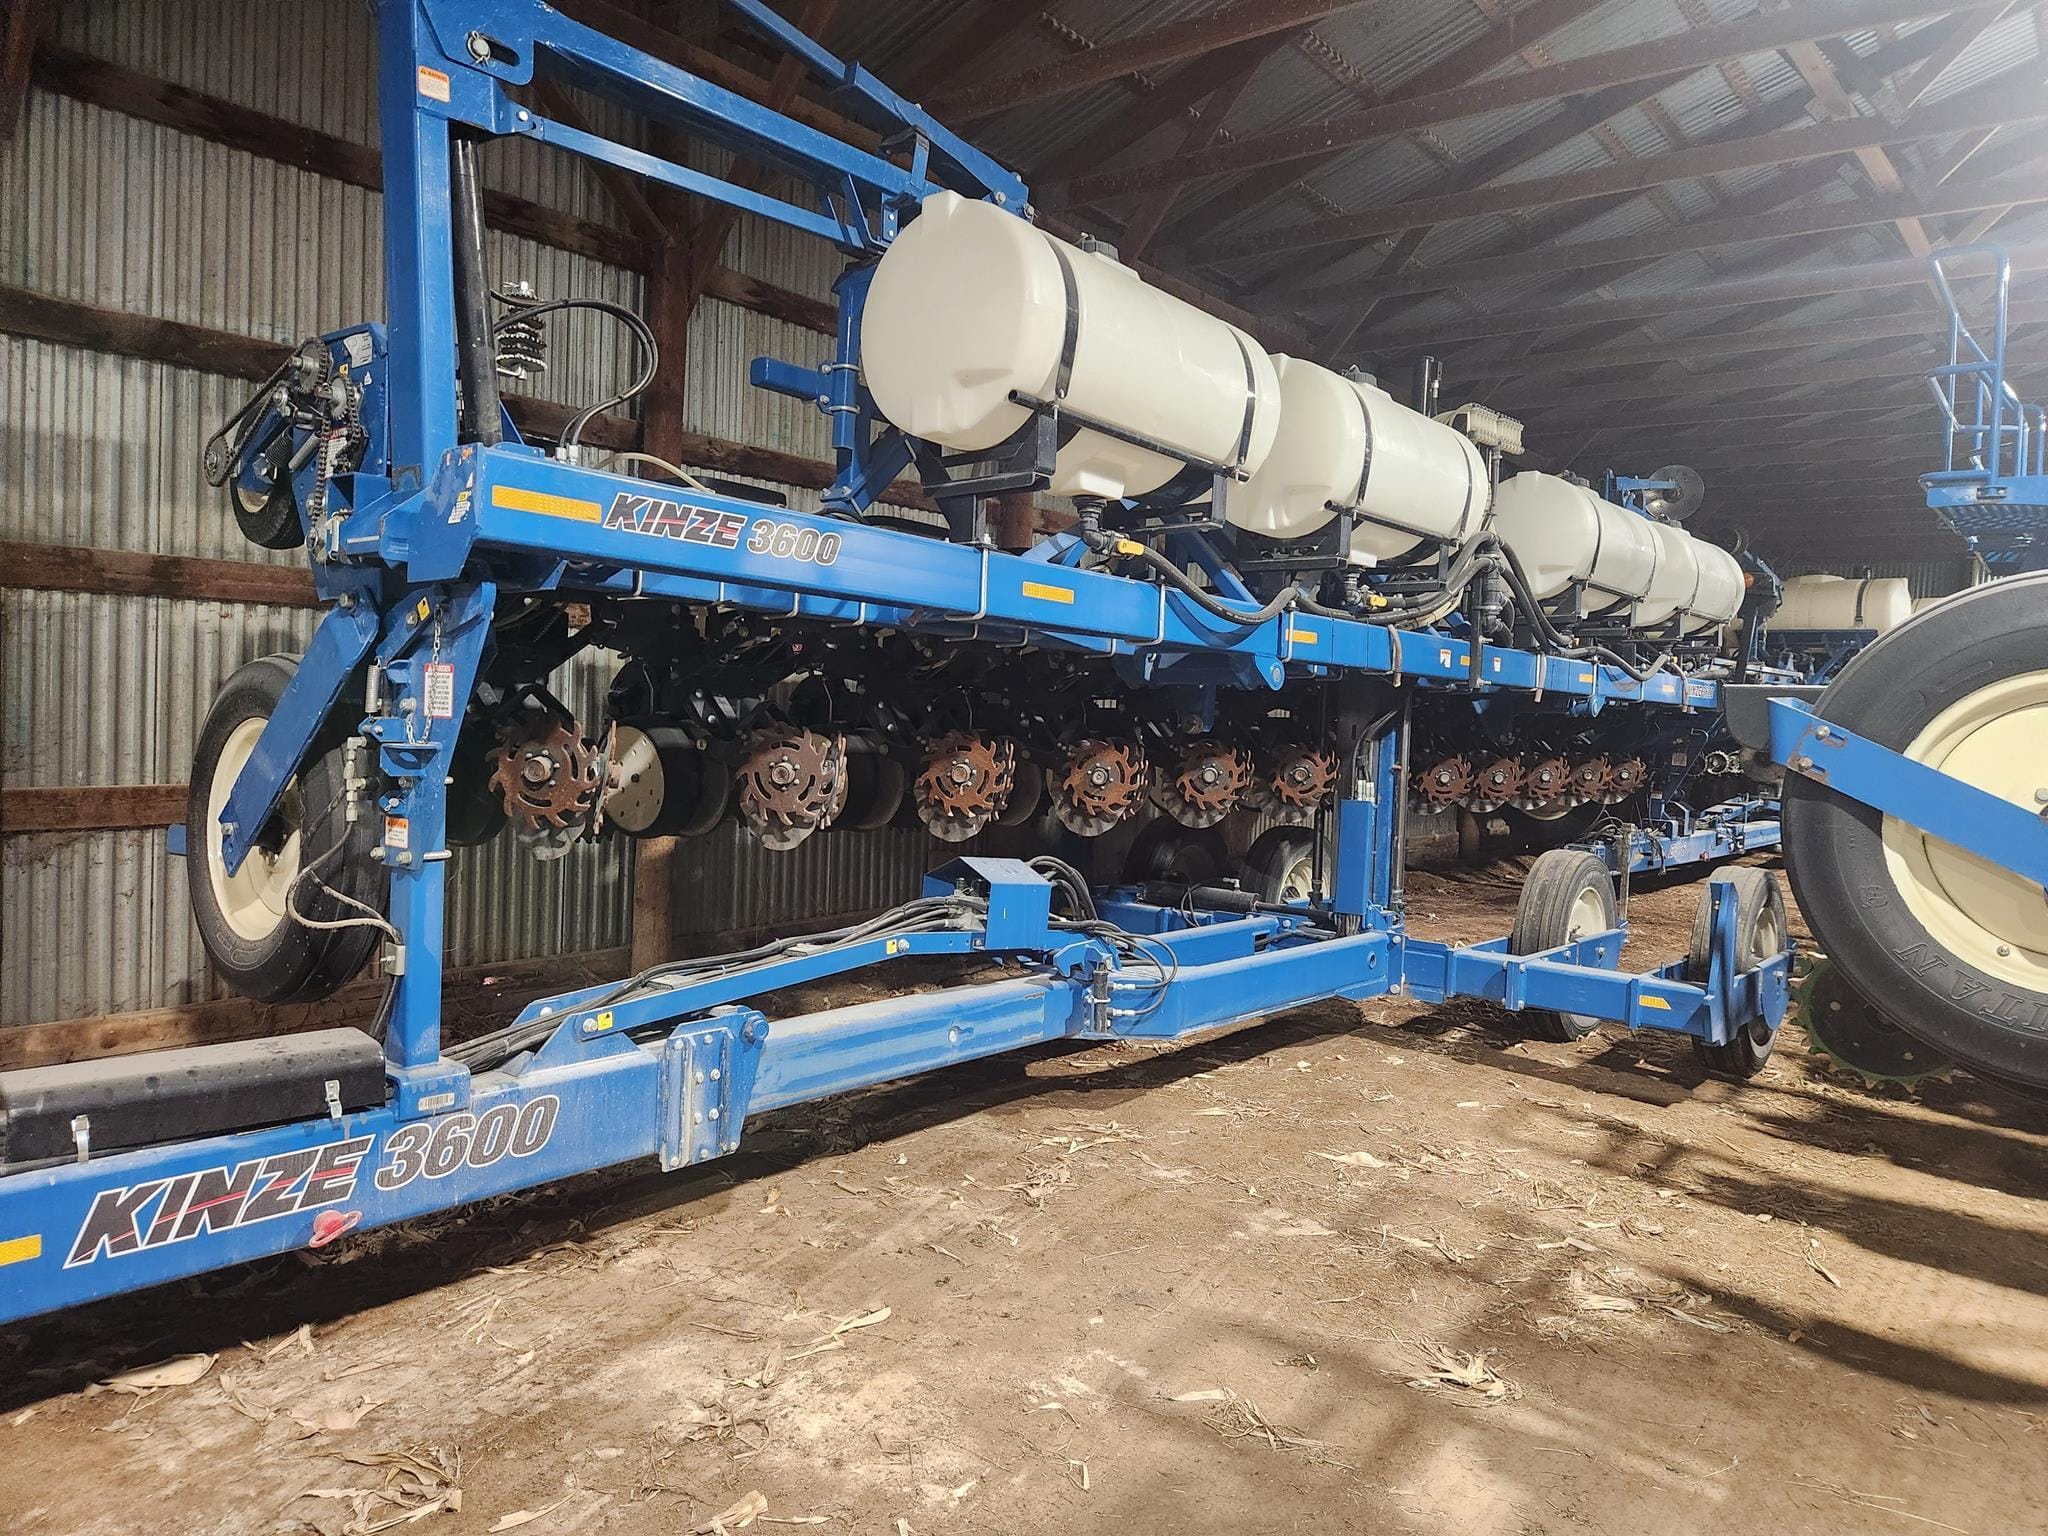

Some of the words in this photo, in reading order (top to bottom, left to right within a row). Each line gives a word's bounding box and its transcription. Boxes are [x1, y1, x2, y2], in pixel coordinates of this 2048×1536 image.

[602, 492, 747, 550] KINZE
[746, 519, 842, 566] 3600
[63, 1134, 378, 1270] KINZE
[375, 1094, 561, 1192] 3600
